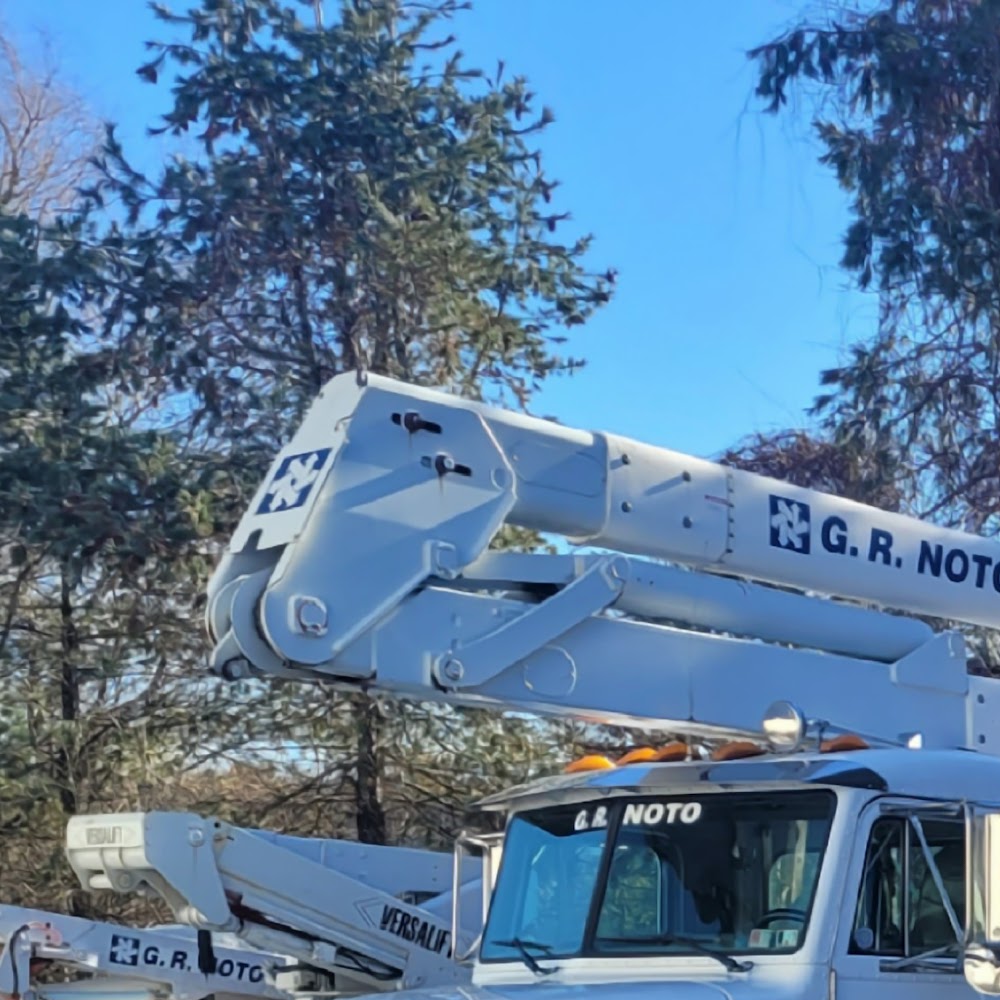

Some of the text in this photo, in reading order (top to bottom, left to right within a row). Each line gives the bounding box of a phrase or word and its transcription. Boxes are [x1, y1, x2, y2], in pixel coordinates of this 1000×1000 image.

[821, 516, 858, 557] G.
[868, 527, 902, 568] R.
[622, 802, 702, 825] NOTO
[143, 946, 264, 983] G. R. OTO
